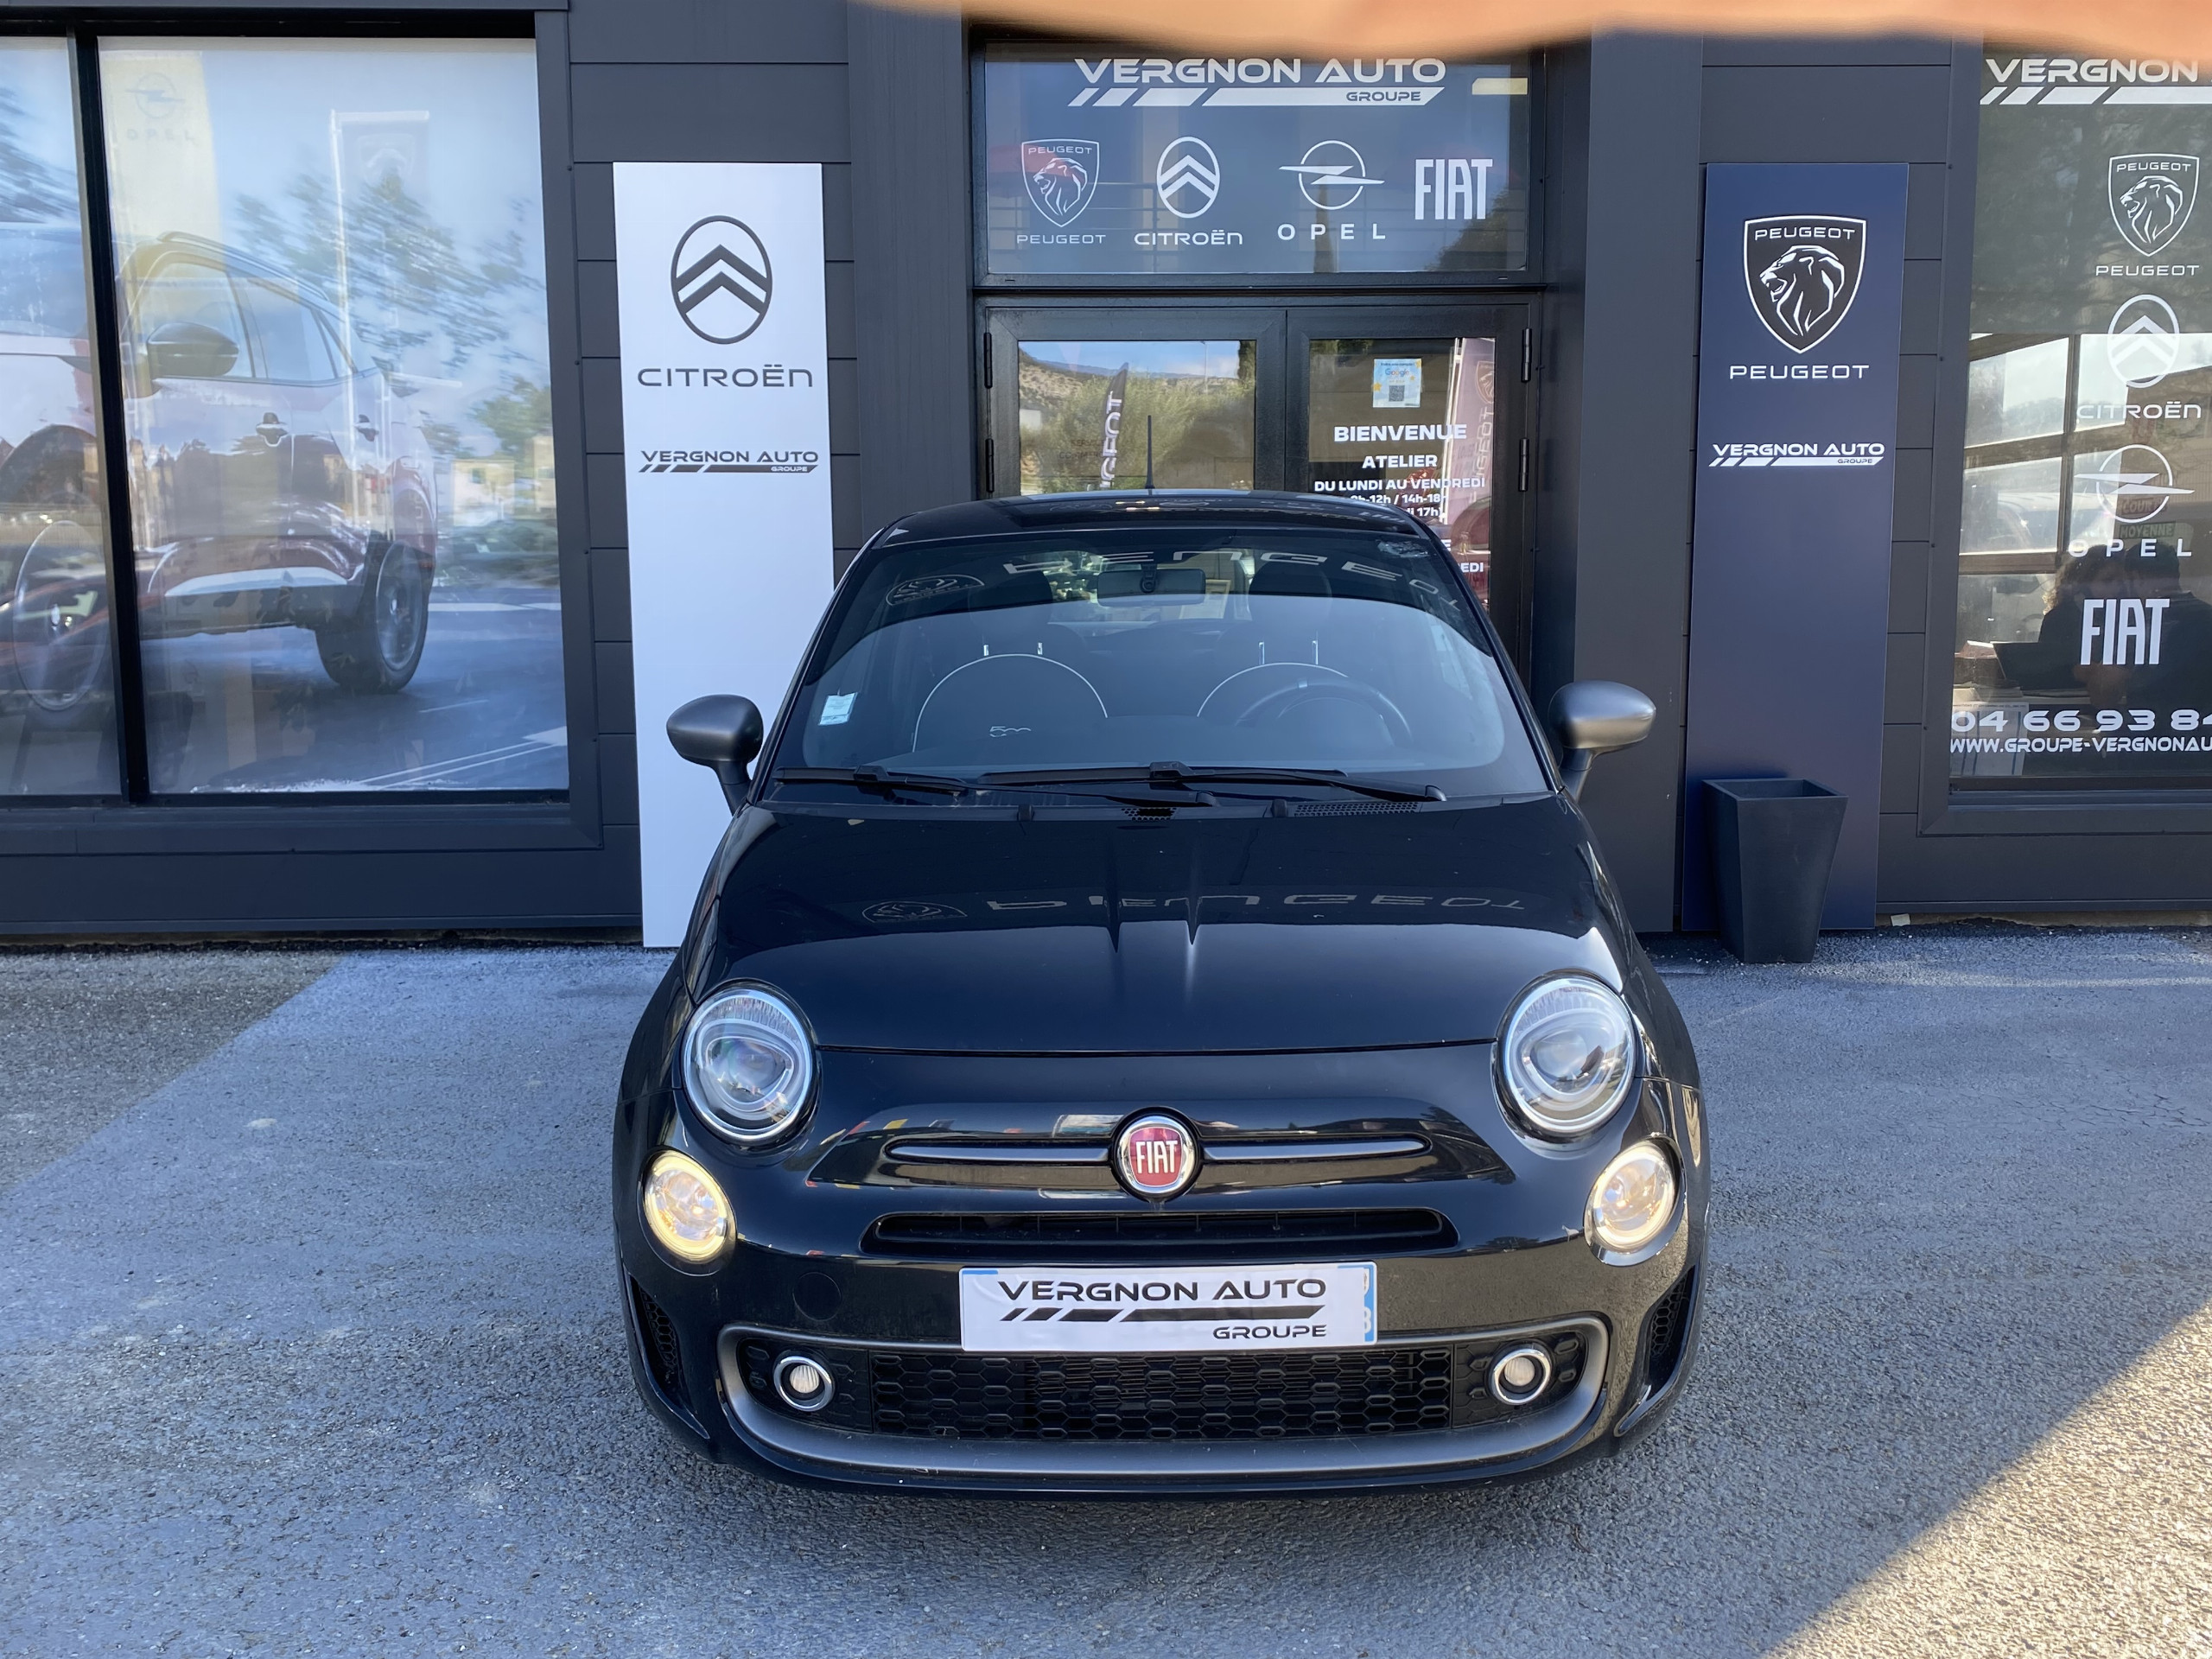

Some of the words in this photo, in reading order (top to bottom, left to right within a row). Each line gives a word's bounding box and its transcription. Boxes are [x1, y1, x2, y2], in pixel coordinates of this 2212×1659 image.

[1073, 58, 1301, 84] VERGNON
[1313, 58, 1446, 84] AUTO
[1986, 58, 2199, 83] VERGNON
[1345, 91, 1421, 102] GROUPE
[1028, 145, 1093, 156] PEUGEOT
[2116, 162, 2192, 173] PEUGEOT
[1414, 159, 1494, 219] FIAT
[1016, 234, 1106, 245] PEUGEOT
[1277, 223, 1386, 241] OPEL
[1754, 226, 1856, 241] PEUGEOT
[2095, 265, 2200, 276] PEUGEOT
[1730, 365, 1870, 379] PEUGEOT
[1334, 423, 1467, 442] BIENVENUE
[640, 450, 750, 463] VERGNON
[756, 450, 819, 463] AUTO
[1712, 443, 1819, 457] VERGNON
[1824, 442, 1885, 456] AUTO
[1362, 454, 1438, 468] ATELIER
[1314, 481, 1336, 492] DU
[1338, 480, 1382, 492] LUNDI
[1386, 480, 1408, 490] AU
[1410, 478, 1485, 489] VENDREDI
[2068, 537, 2192, 557] OPEL
[2080, 598, 2171, 665] FIAT
[1951, 710, 2009, 733] 04
[2023, 710, 2082, 733] 66
[2095, 709, 2156, 731] 93
[1135, 1139, 1178, 1175] FIAT
[998, 1281, 1196, 1302] VERGNON
[1211, 1279, 1327, 1300] AUTO
[1212, 1325, 1326, 1340] GROUPE
